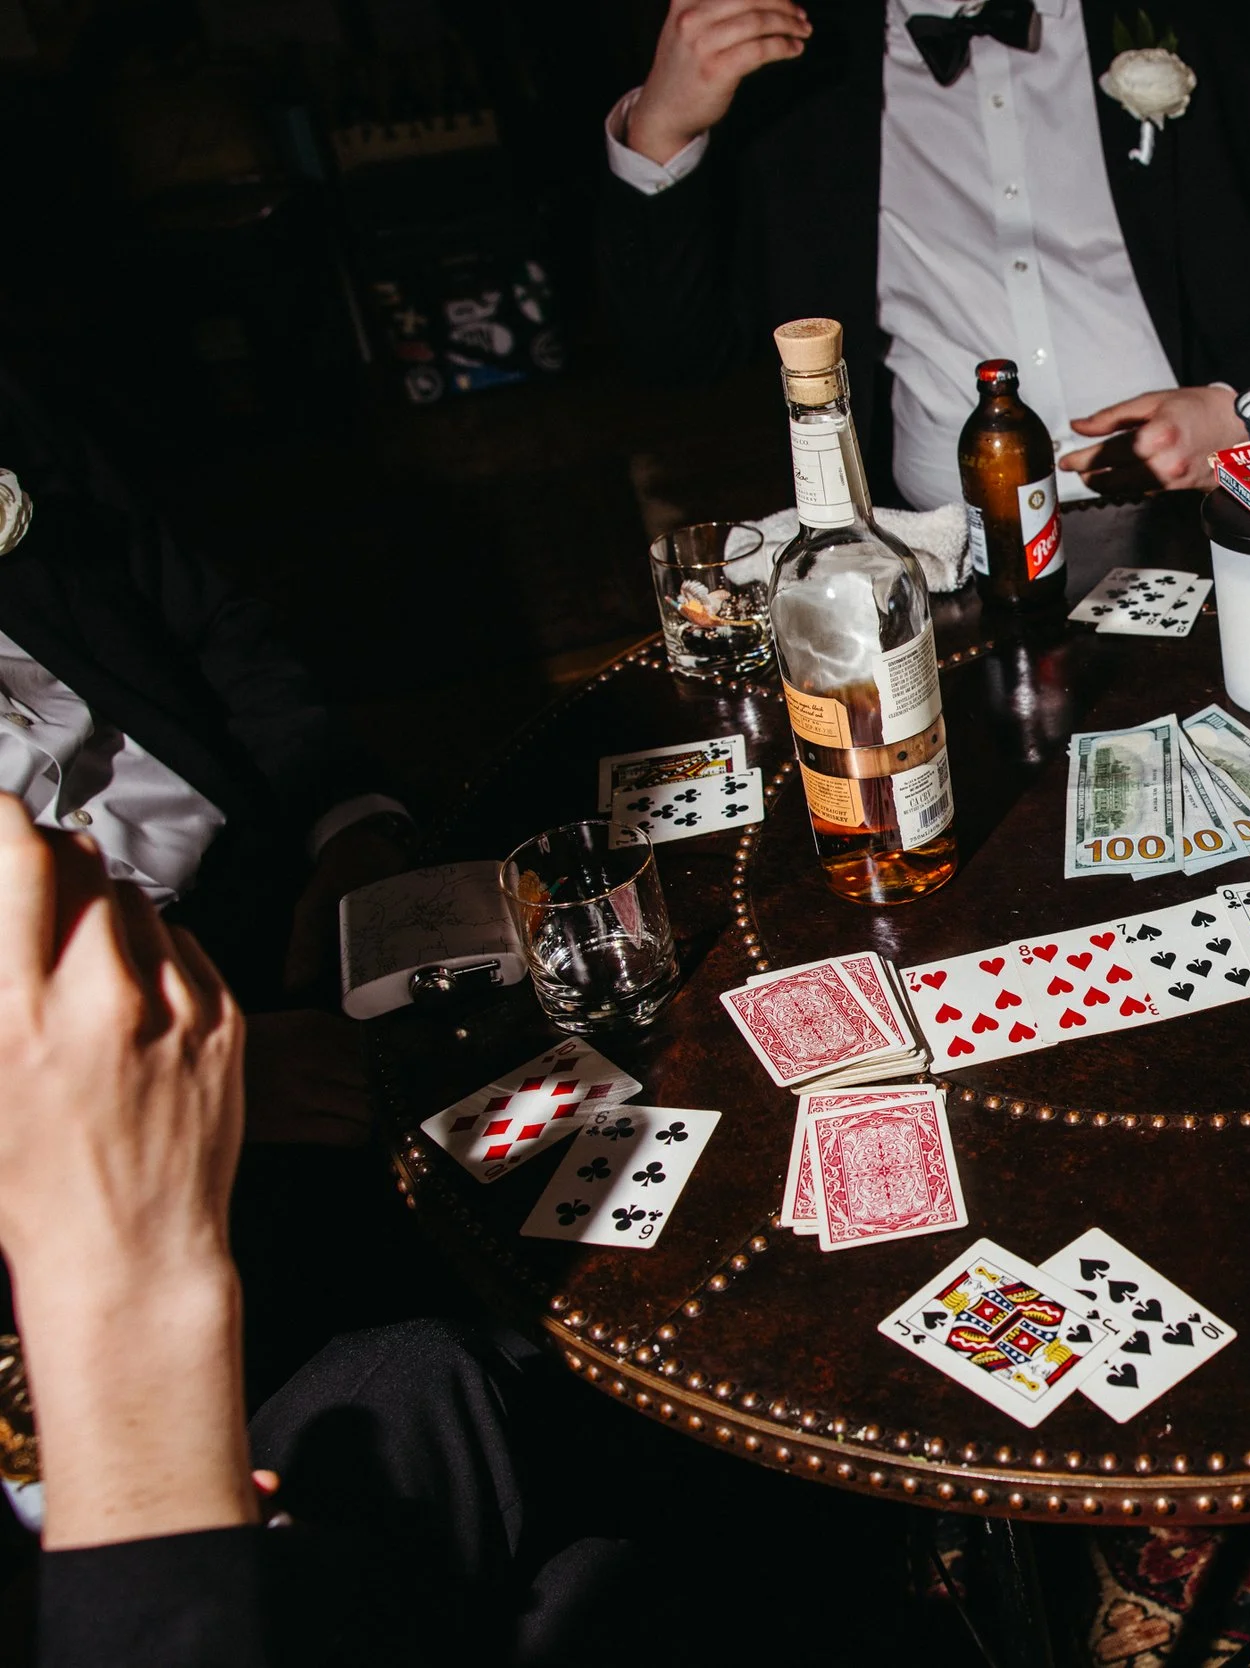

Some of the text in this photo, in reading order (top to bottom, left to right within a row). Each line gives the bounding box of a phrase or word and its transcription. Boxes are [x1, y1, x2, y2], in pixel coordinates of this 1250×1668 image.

[1032, 520, 1058, 567] Red
[820, 805, 848, 817] STRAIGHT
[821, 811, 848, 823] WHISKEY
[1084, 835, 1166, 863] 100
[1223, 889, 1237, 901] Q
[1116, 923, 1128, 936] 7
[1018, 944, 1030, 957] 8
[906, 971, 917, 984] 7
[556, 1041, 577, 1057] 10
[595, 1110, 611, 1125] 6
[483, 1162, 507, 1182] 10
[893, 1319, 913, 1337] J
[1102, 1317, 1122, 1337] J
[1201, 1320, 1226, 1341] 10
